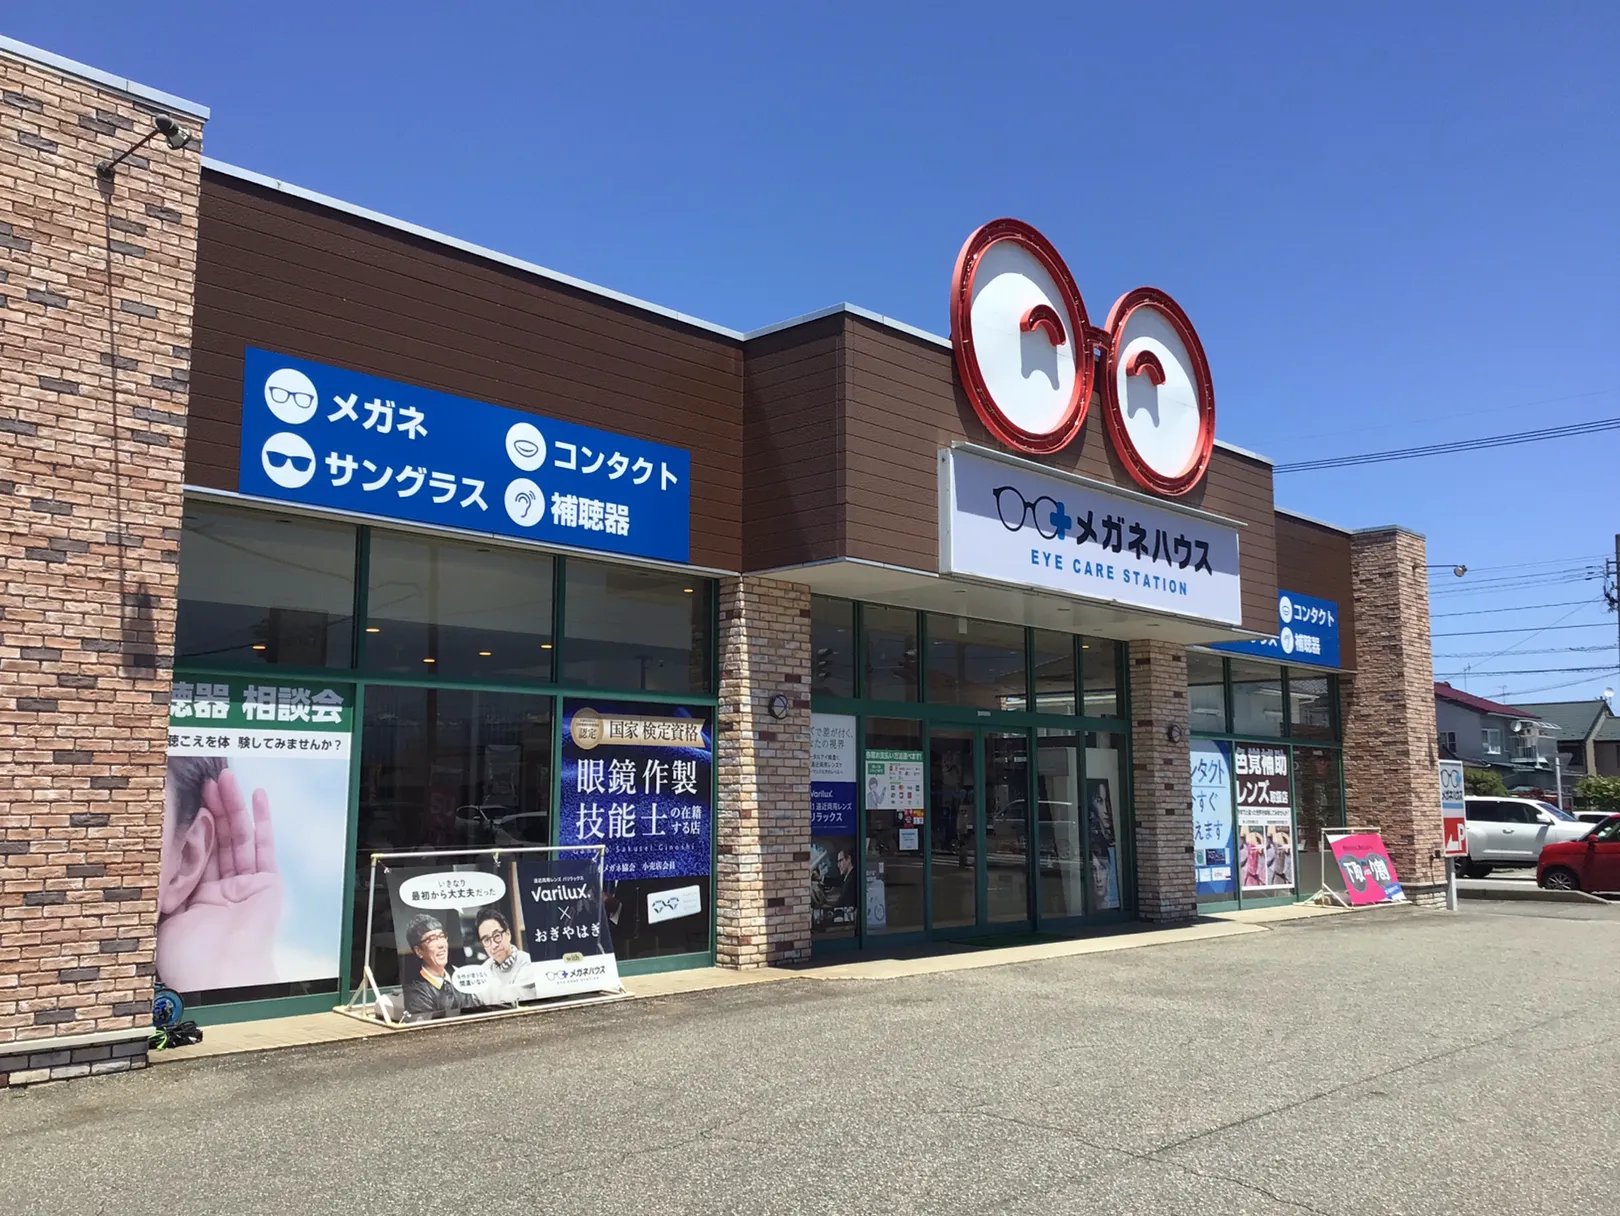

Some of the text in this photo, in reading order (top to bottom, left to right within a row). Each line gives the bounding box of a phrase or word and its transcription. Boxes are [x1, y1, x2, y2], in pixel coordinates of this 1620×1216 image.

[326, 392, 428, 440] メガネ
[324, 450, 489, 512] サングラス
[554, 440, 678, 491] コンタクト
[551, 491, 631, 537] 補聴器
[1076, 511, 1213, 576] メガネハウス
[1031, 549, 1188, 596] EYE CARE STATION
[1293, 604, 1334, 627] コンタクト
[1294, 633, 1321, 655] 補聴器
[242, 684, 344, 724] 相談会
[609, 720, 698, 742] 国家検定資格
[577, 758, 698, 796] 眼鏡作製
[1235, 746, 1287, 776] 色覚補助
[576, 802, 668, 840] 技能士
[671, 821, 700, 835] する店
[412, 888, 496, 901] 最初から大丈夫だった
[535, 922, 600, 942] おぎやはぎ
[570, 965, 606, 978] メガネハウス
